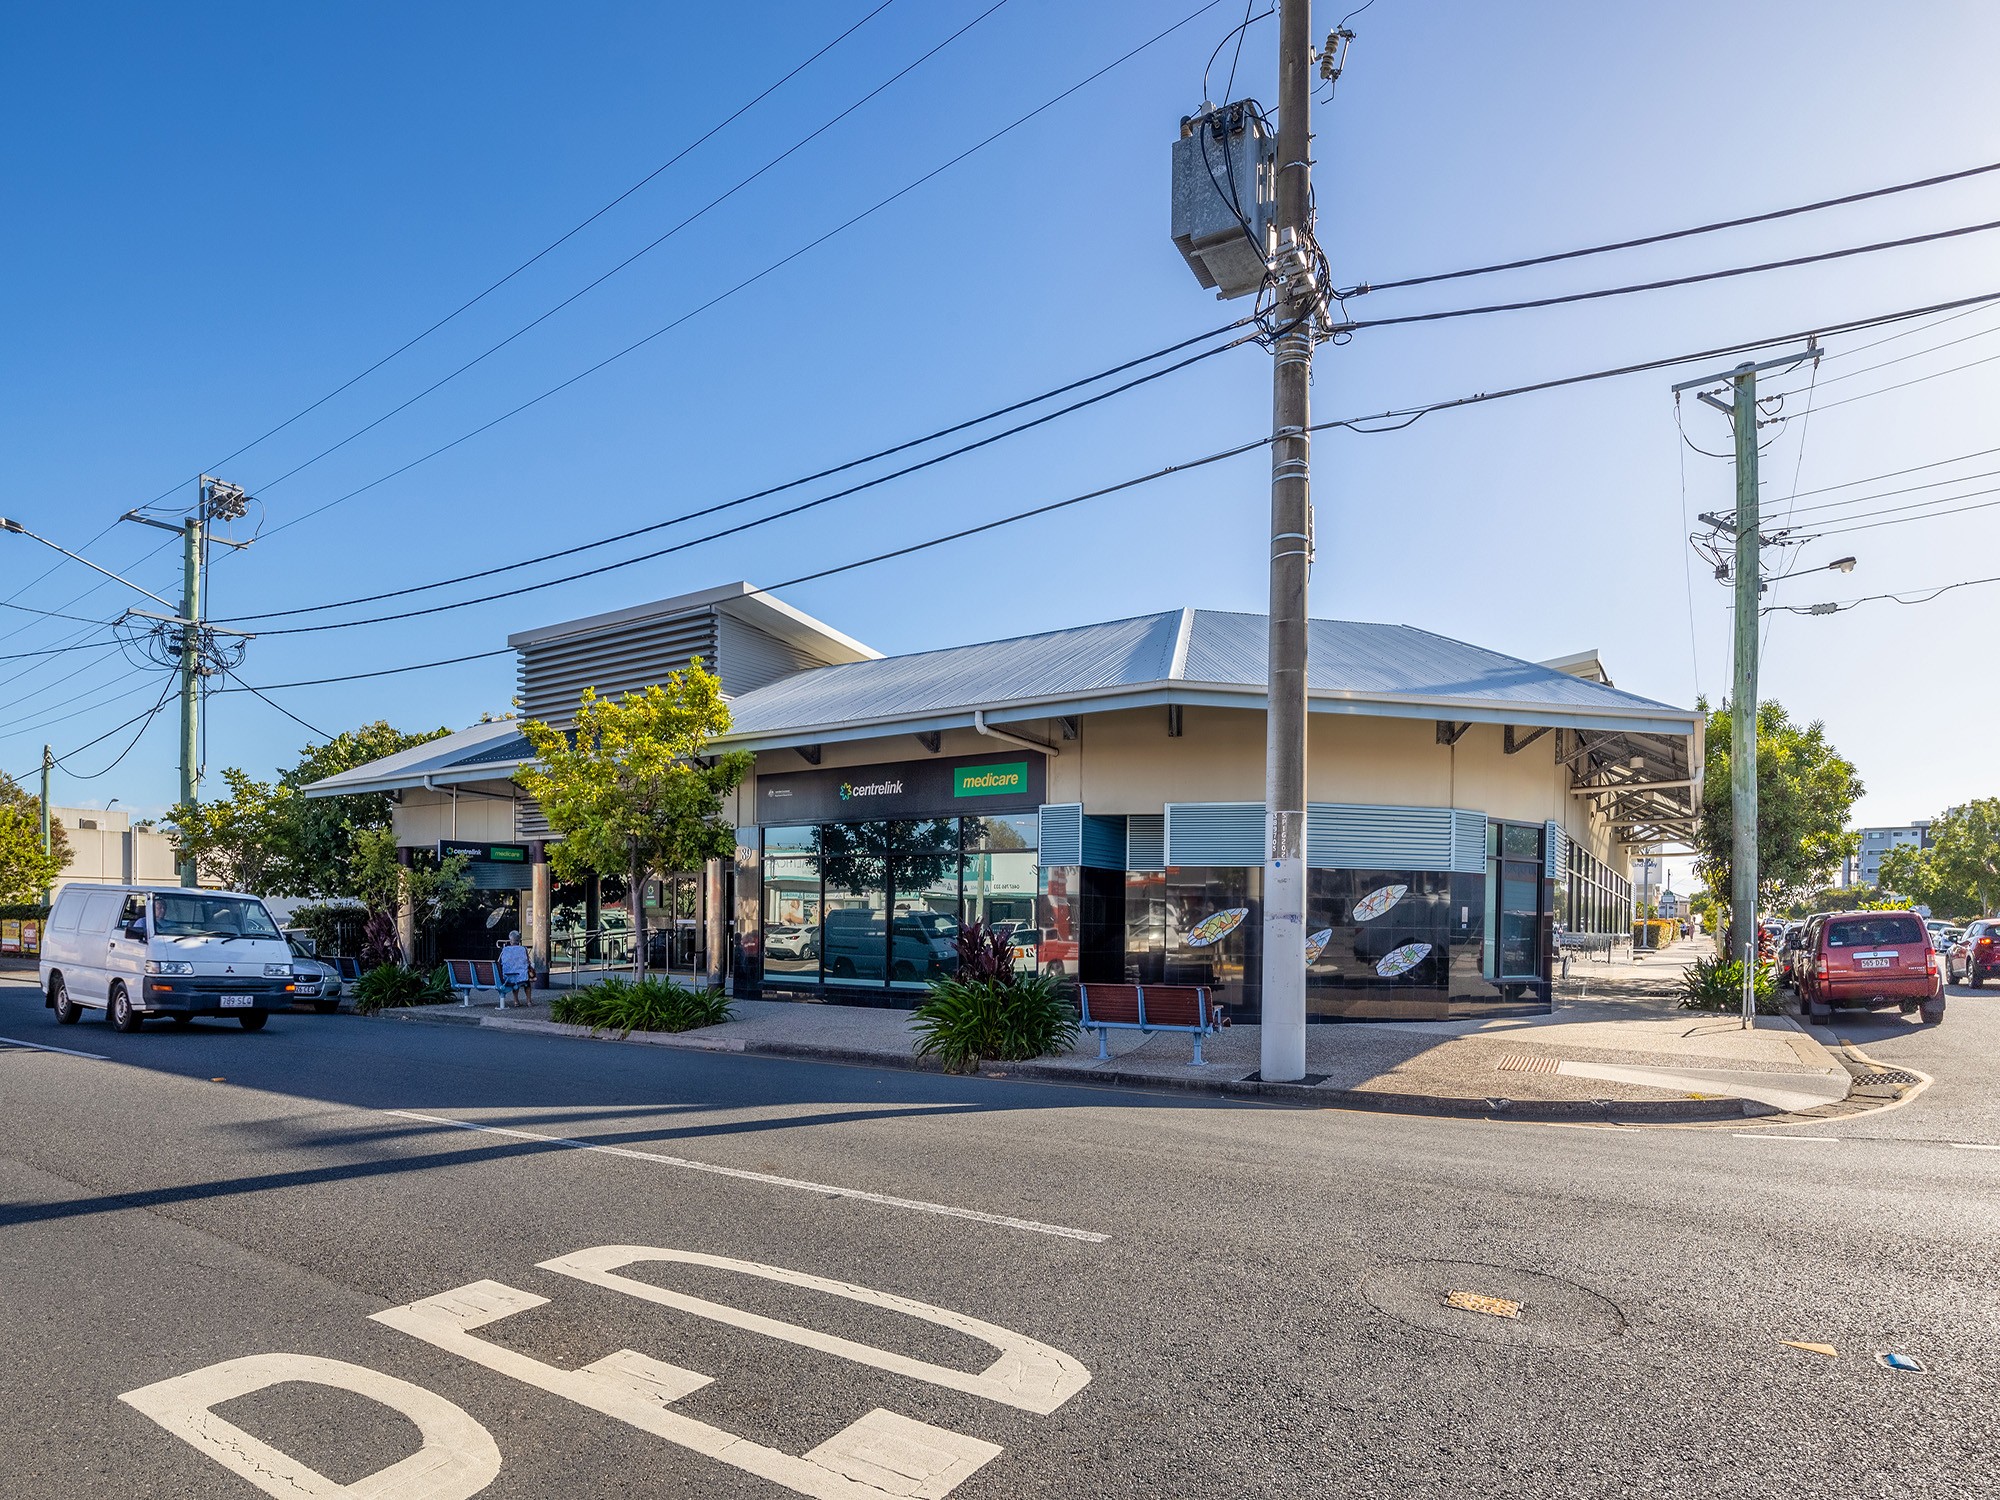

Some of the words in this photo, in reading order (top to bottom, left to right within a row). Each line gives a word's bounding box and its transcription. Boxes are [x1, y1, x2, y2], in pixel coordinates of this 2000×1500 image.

[963, 772, 1019, 788] medicare
[852, 780, 903, 797] centrelink
[494, 850, 520, 858] medicare
[741, 848, 752, 860] 89
